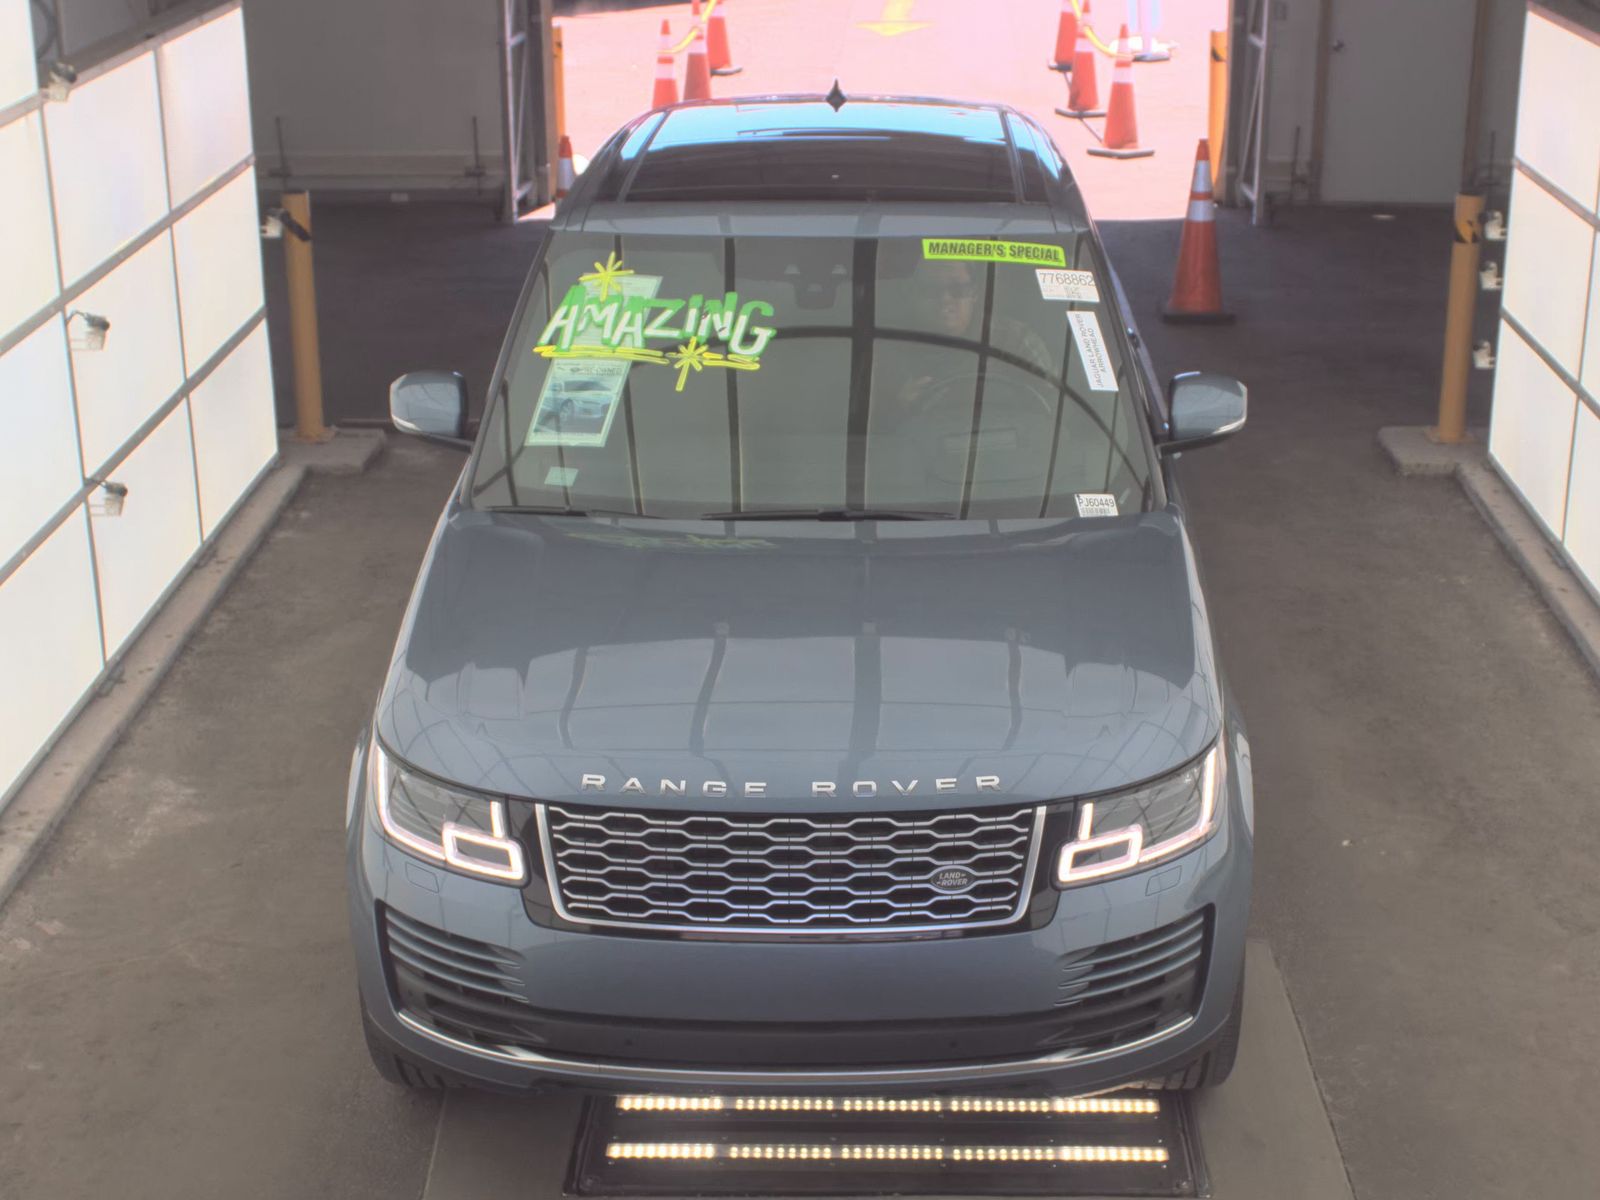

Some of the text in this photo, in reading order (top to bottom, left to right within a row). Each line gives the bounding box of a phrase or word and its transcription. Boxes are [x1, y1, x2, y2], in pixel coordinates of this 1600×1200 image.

[928, 241, 1061, 262] MANAGER'S SPECIAL
[1040, 272, 1096, 287] 7768862
[537, 283, 777, 359] AMAZING
[1075, 313, 1104, 388] JAGUAR LAND ROVER
[1088, 327, 1106, 373] ARROWHEAD
[580, 773, 1001, 798] RANGE ROVER
